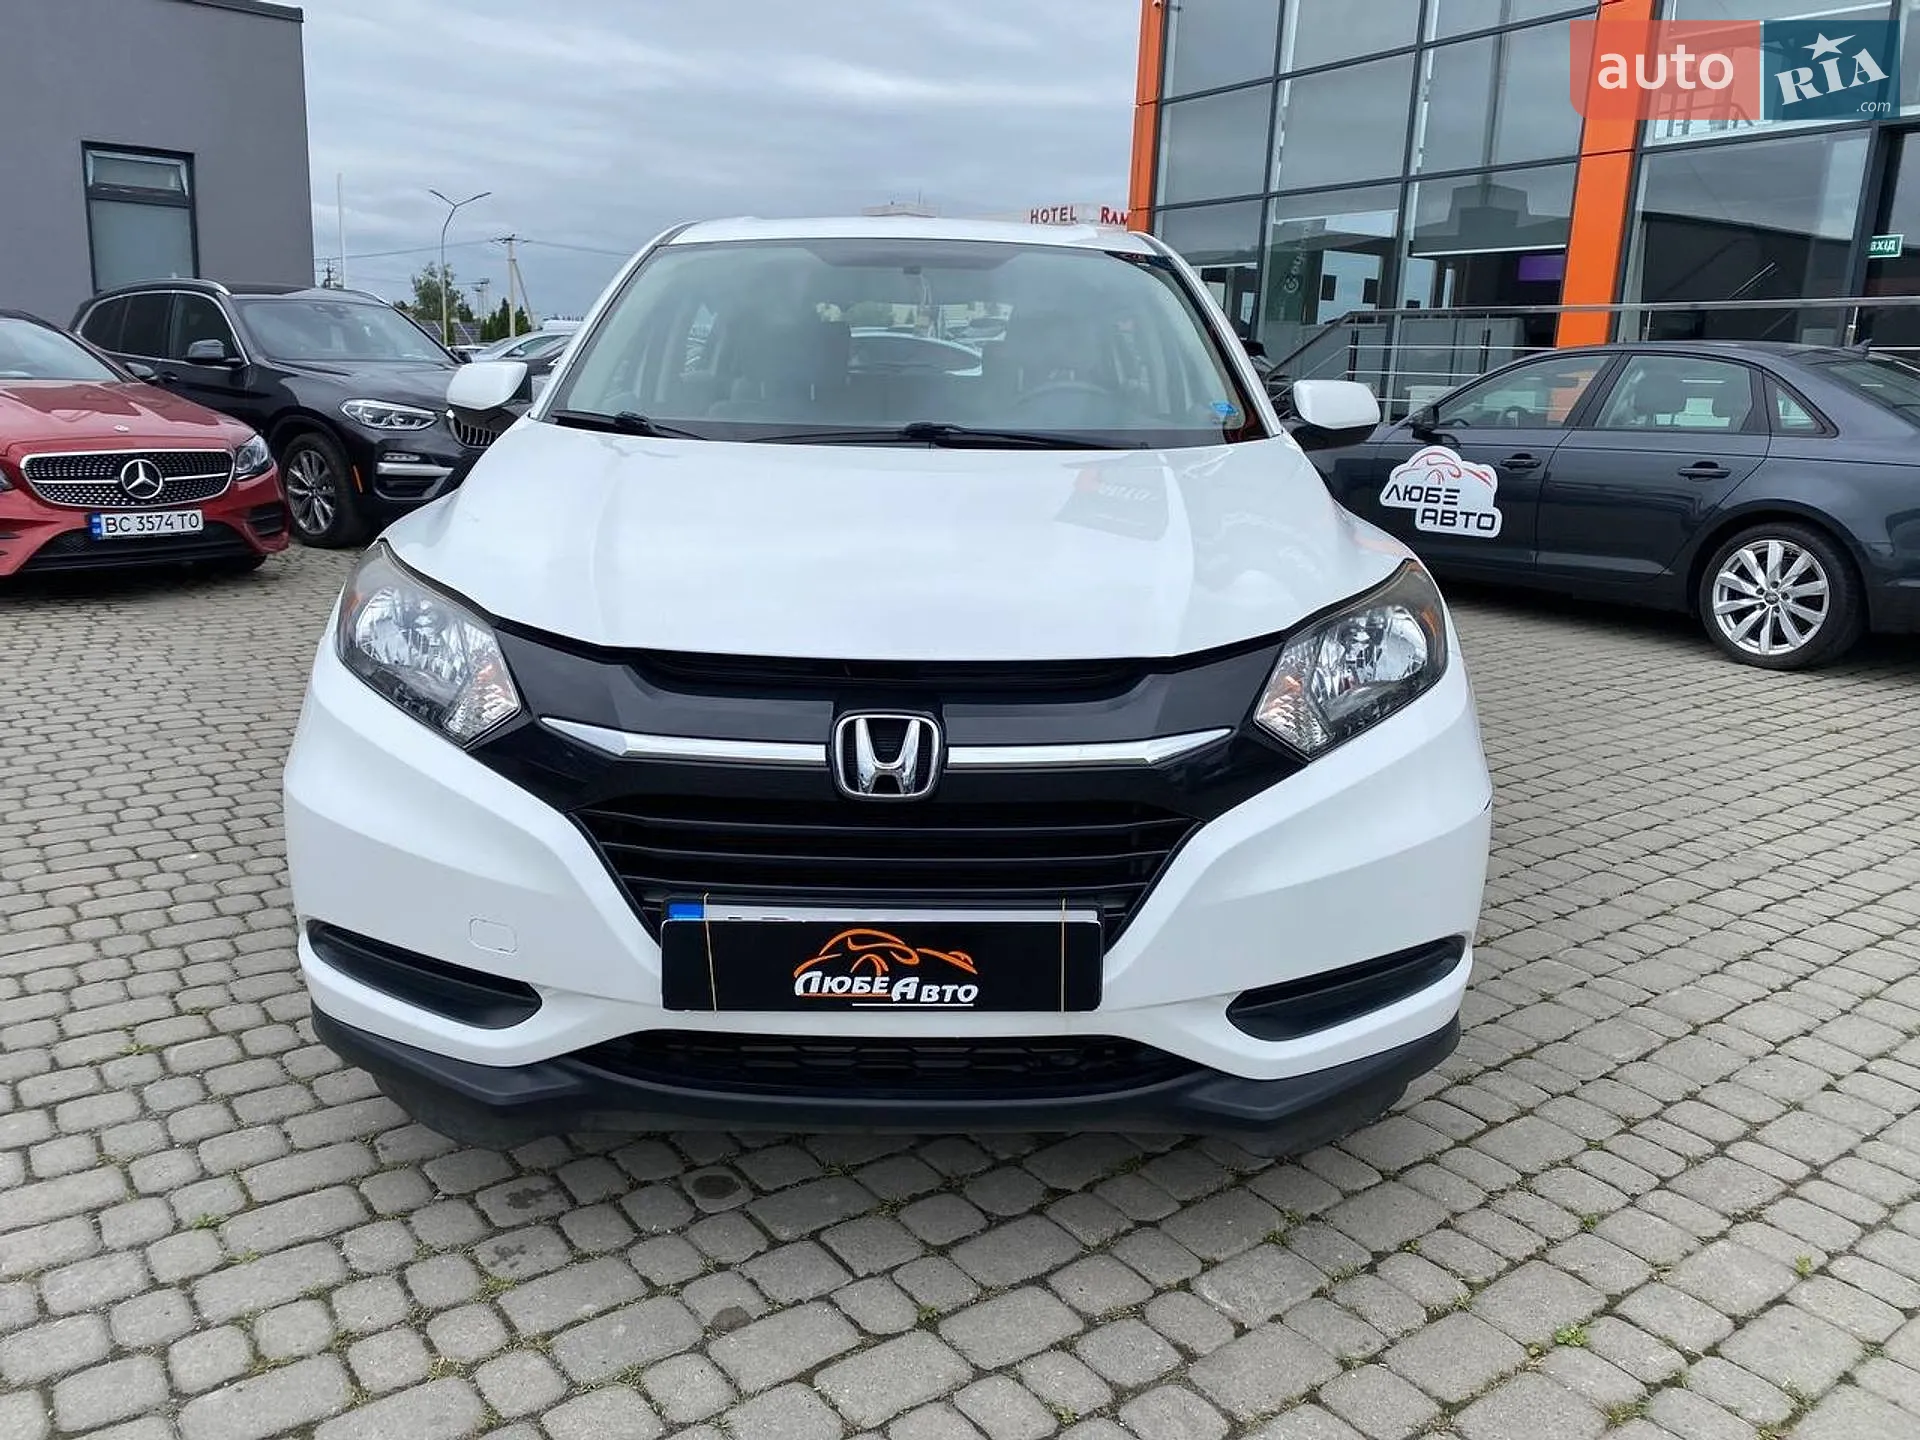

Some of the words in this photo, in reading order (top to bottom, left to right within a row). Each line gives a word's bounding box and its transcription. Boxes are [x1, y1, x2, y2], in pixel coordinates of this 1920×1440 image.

[1030, 206, 1077, 225] HOTEL
[1384, 483, 1461, 506] ЛЮБЕ
[105, 516, 131, 533] BC
[136, 514, 174, 532] 3574
[1420, 508, 1497, 531] АВТО
